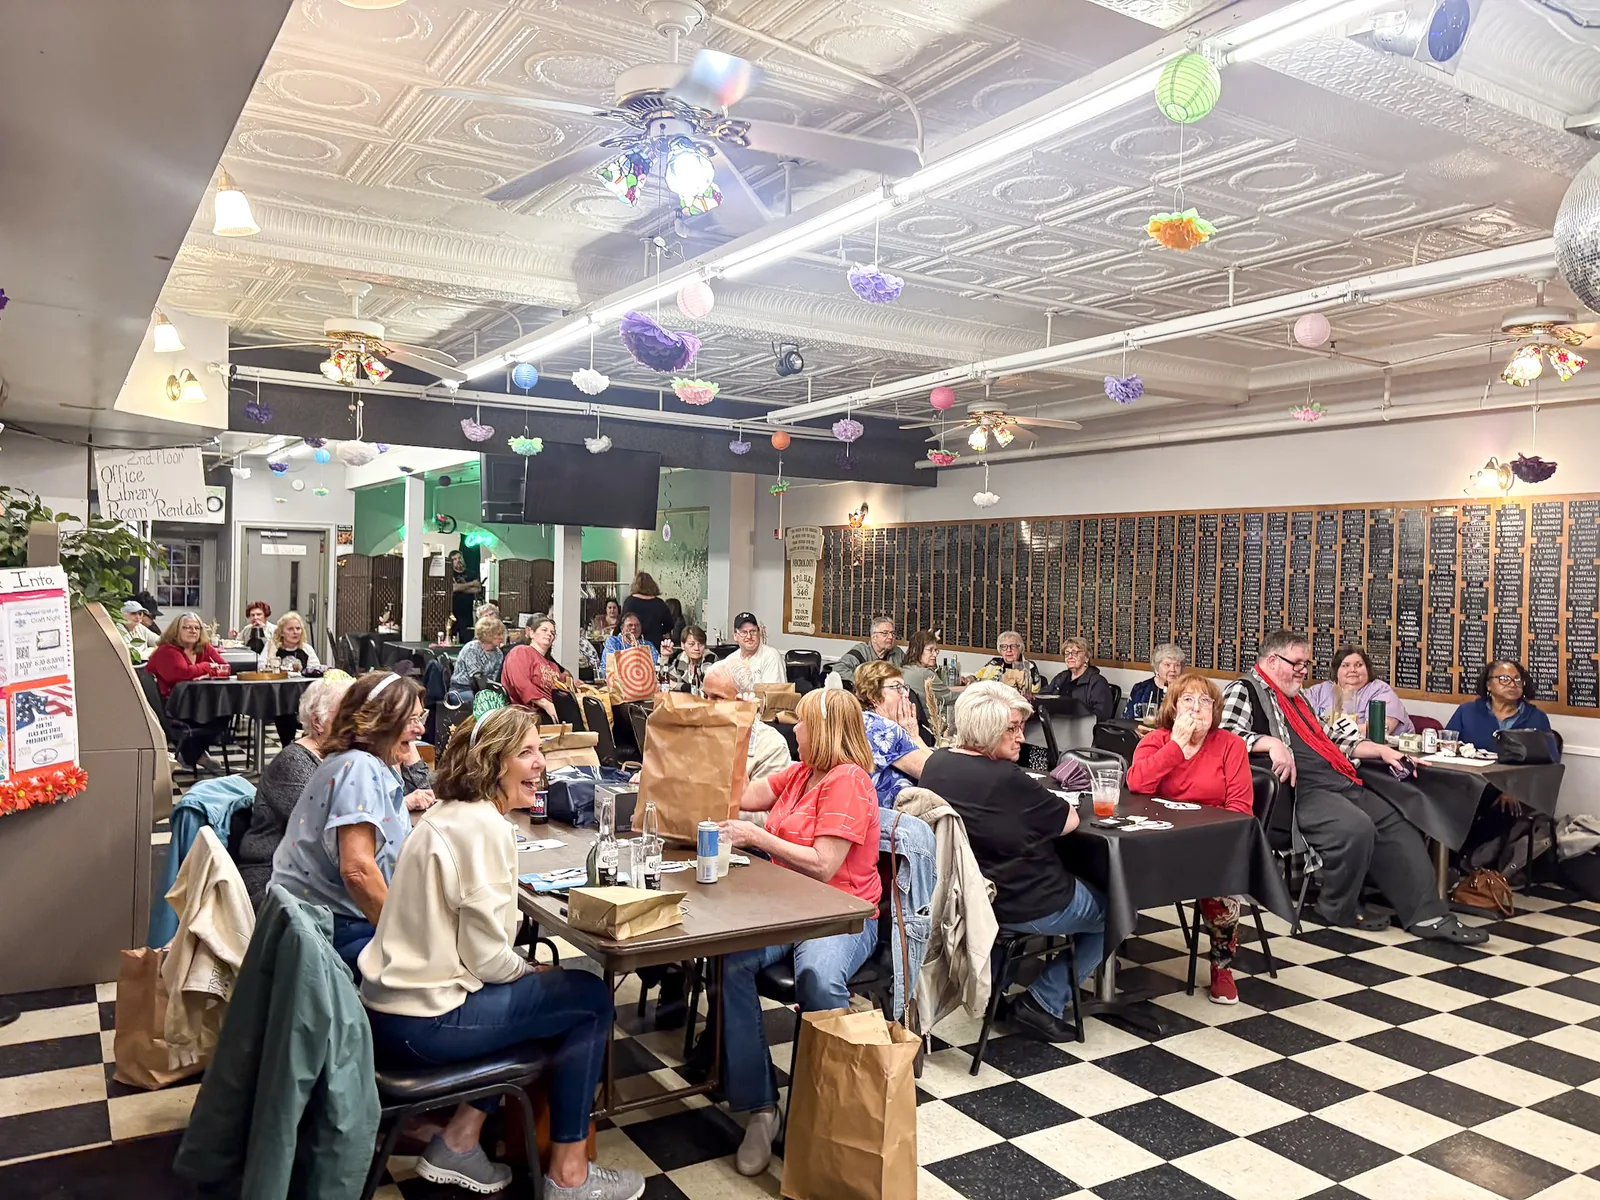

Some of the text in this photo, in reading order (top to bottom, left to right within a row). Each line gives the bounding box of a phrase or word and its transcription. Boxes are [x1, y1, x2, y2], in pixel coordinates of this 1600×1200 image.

[128, 451, 153, 465] 2nd
[101, 465, 145, 484] Office
[106, 482, 158, 506] Library
[108, 497, 204, 520] Room Rentals
